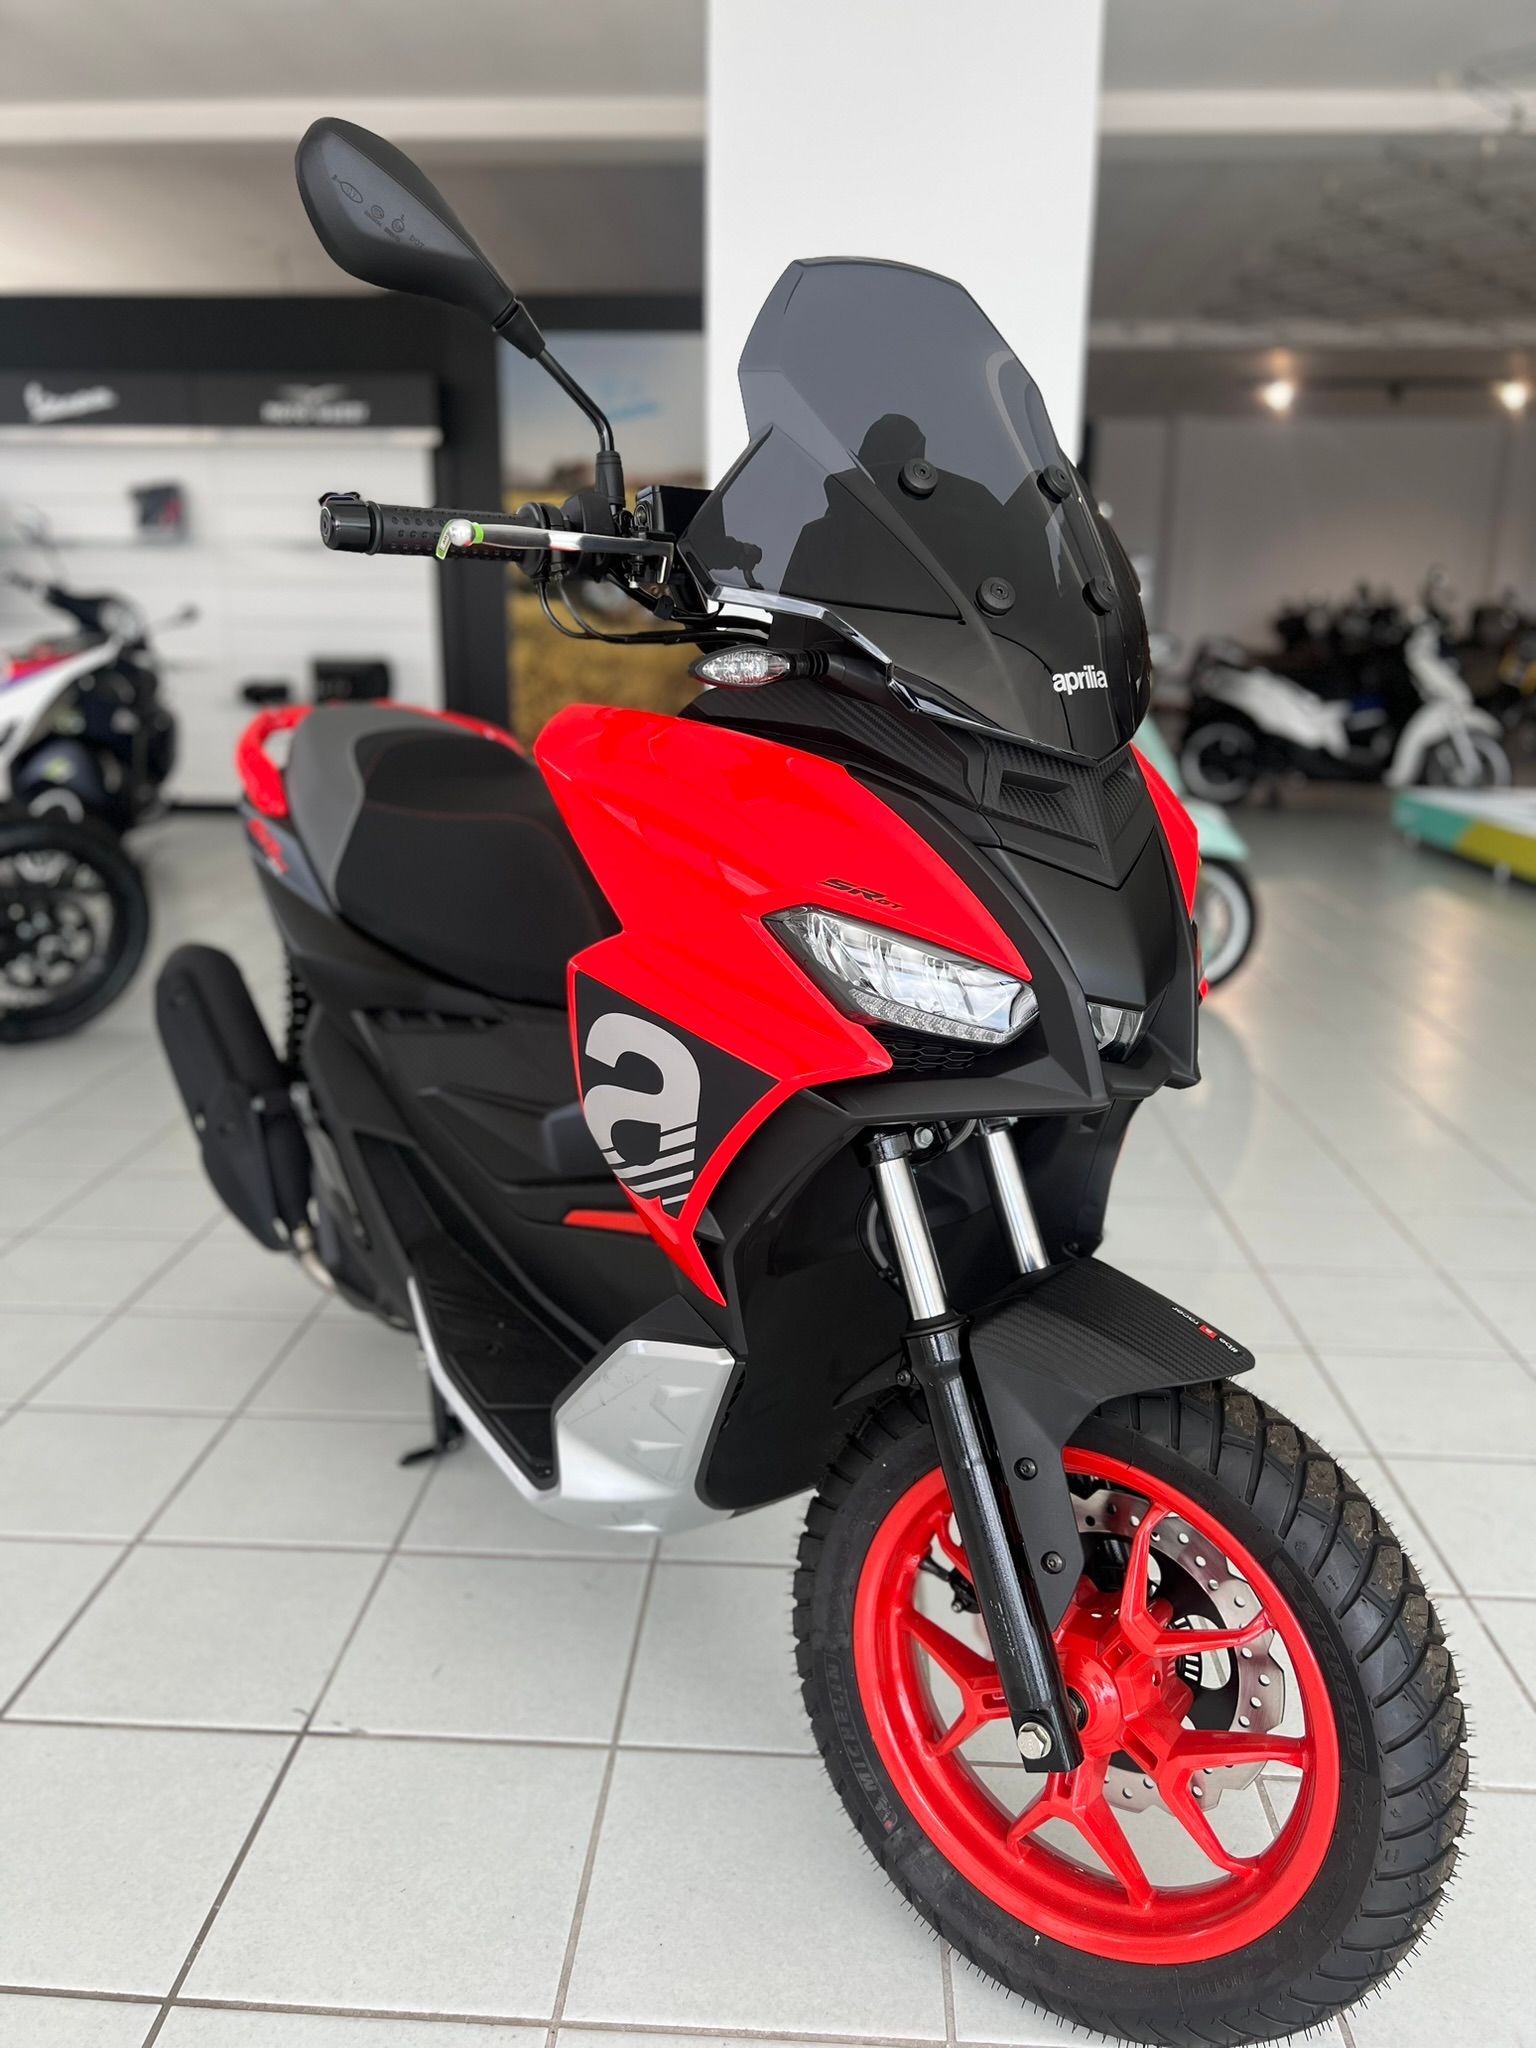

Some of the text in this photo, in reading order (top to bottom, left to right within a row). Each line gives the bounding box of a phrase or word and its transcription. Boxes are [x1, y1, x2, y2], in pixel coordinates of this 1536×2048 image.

[1052, 664, 1108, 695] aprilia
[827, 1663, 877, 1793] MICHELIN
[1299, 1600, 1363, 1761] MICHELIN
